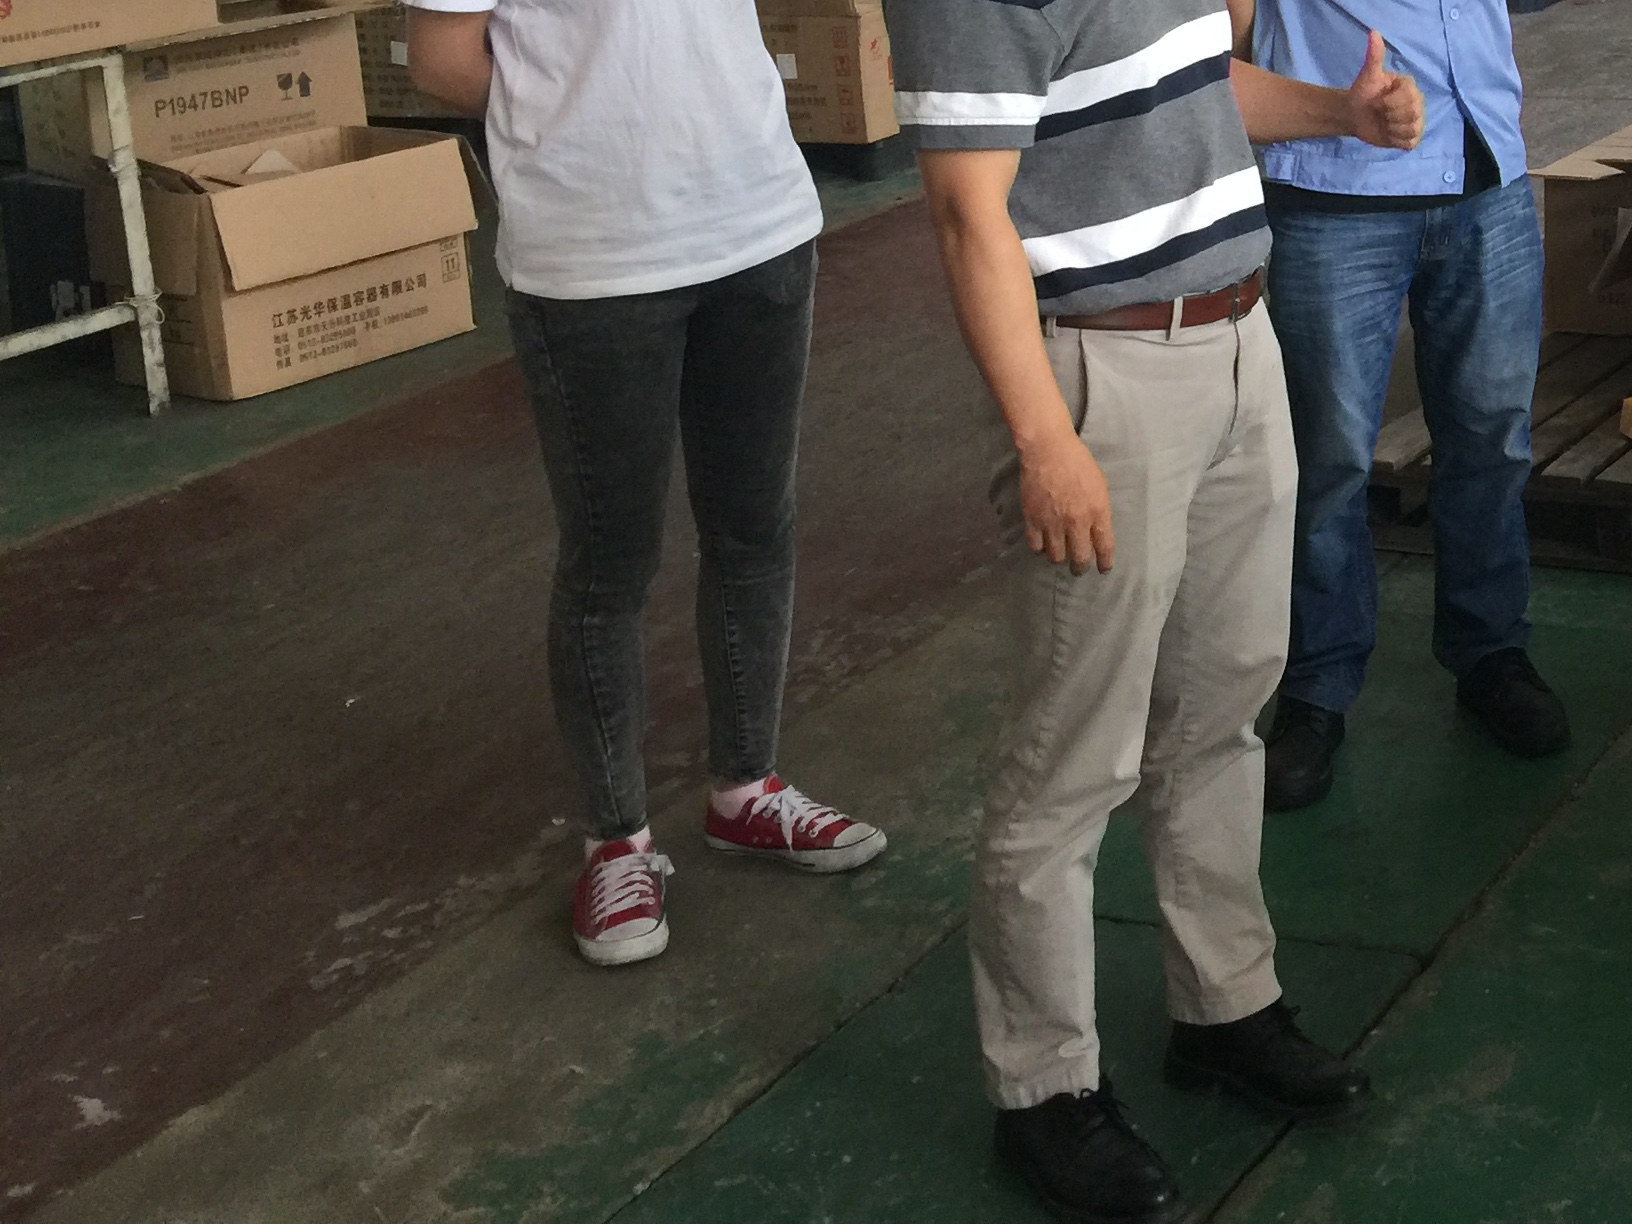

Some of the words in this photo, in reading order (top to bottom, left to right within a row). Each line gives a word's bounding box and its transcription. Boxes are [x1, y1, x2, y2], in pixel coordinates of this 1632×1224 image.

[155, 85, 249, 118] P1947BNP
[272, 273, 428, 328] 江苏光华保温容器有限公司
